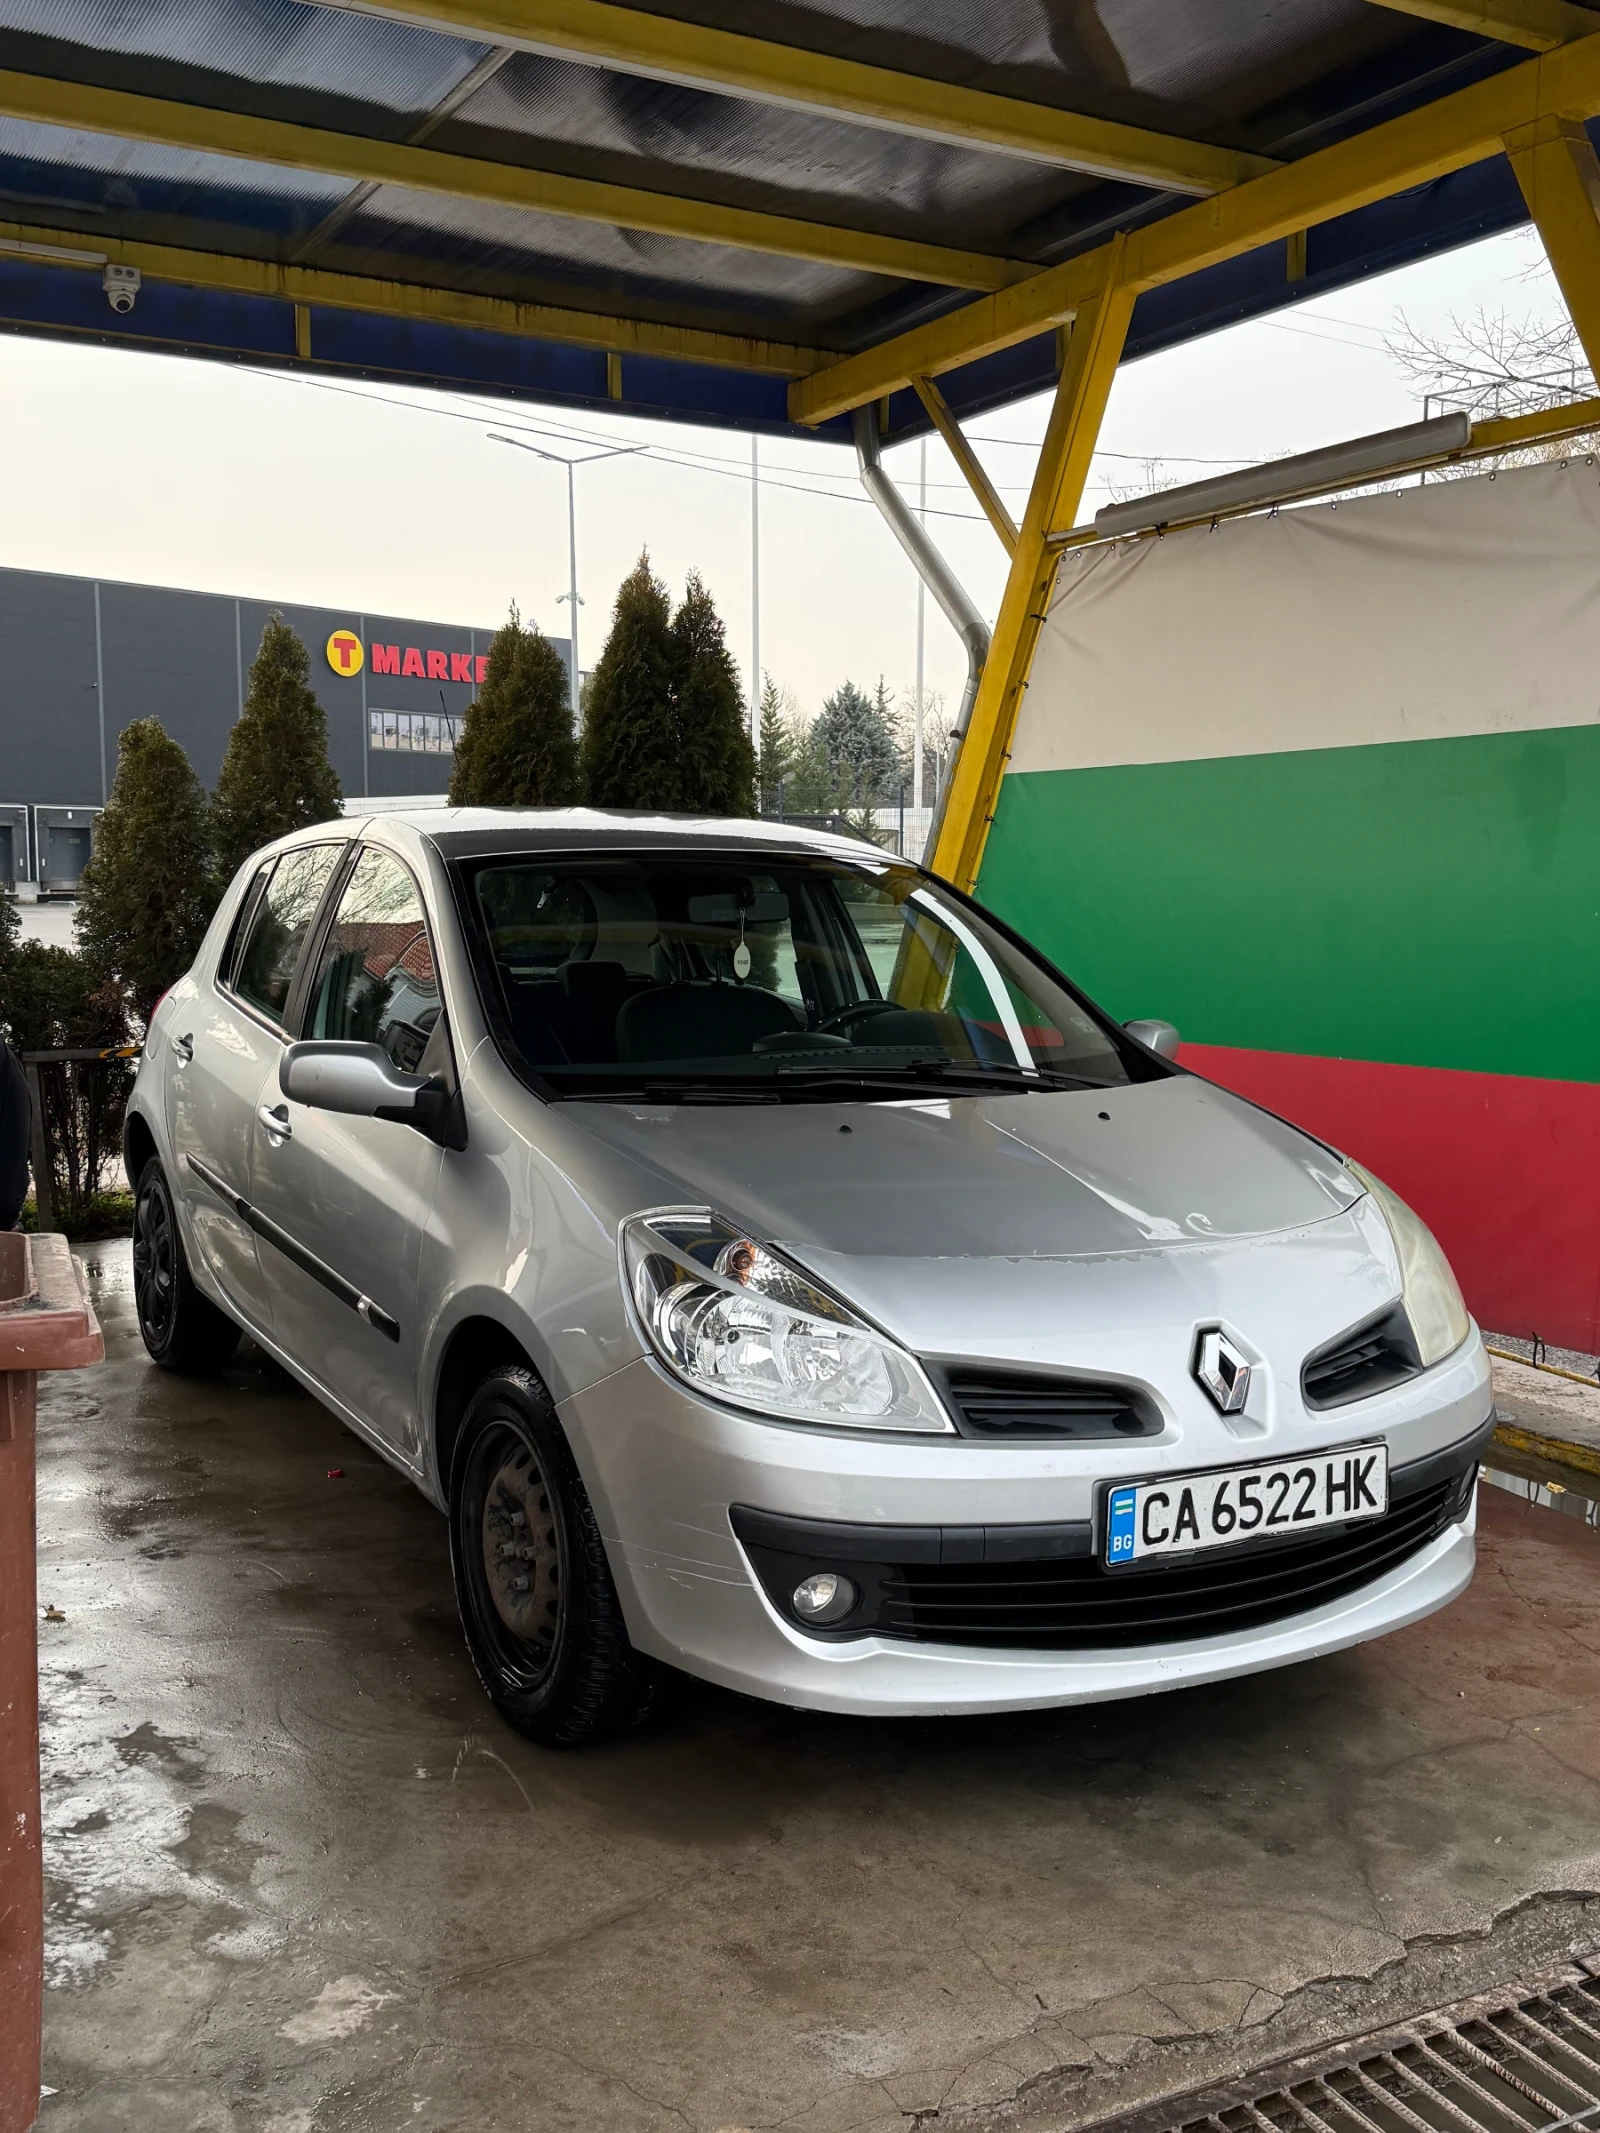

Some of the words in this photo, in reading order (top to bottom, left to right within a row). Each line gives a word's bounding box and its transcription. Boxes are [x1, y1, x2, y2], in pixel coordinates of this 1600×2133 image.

[333, 637, 357, 669] T
[1142, 1487, 1201, 1546] CA
[1211, 1467, 1317, 1535] 6522
[1325, 1454, 1378, 1516] HK
[1112, 1535, 1133, 1553] BG
